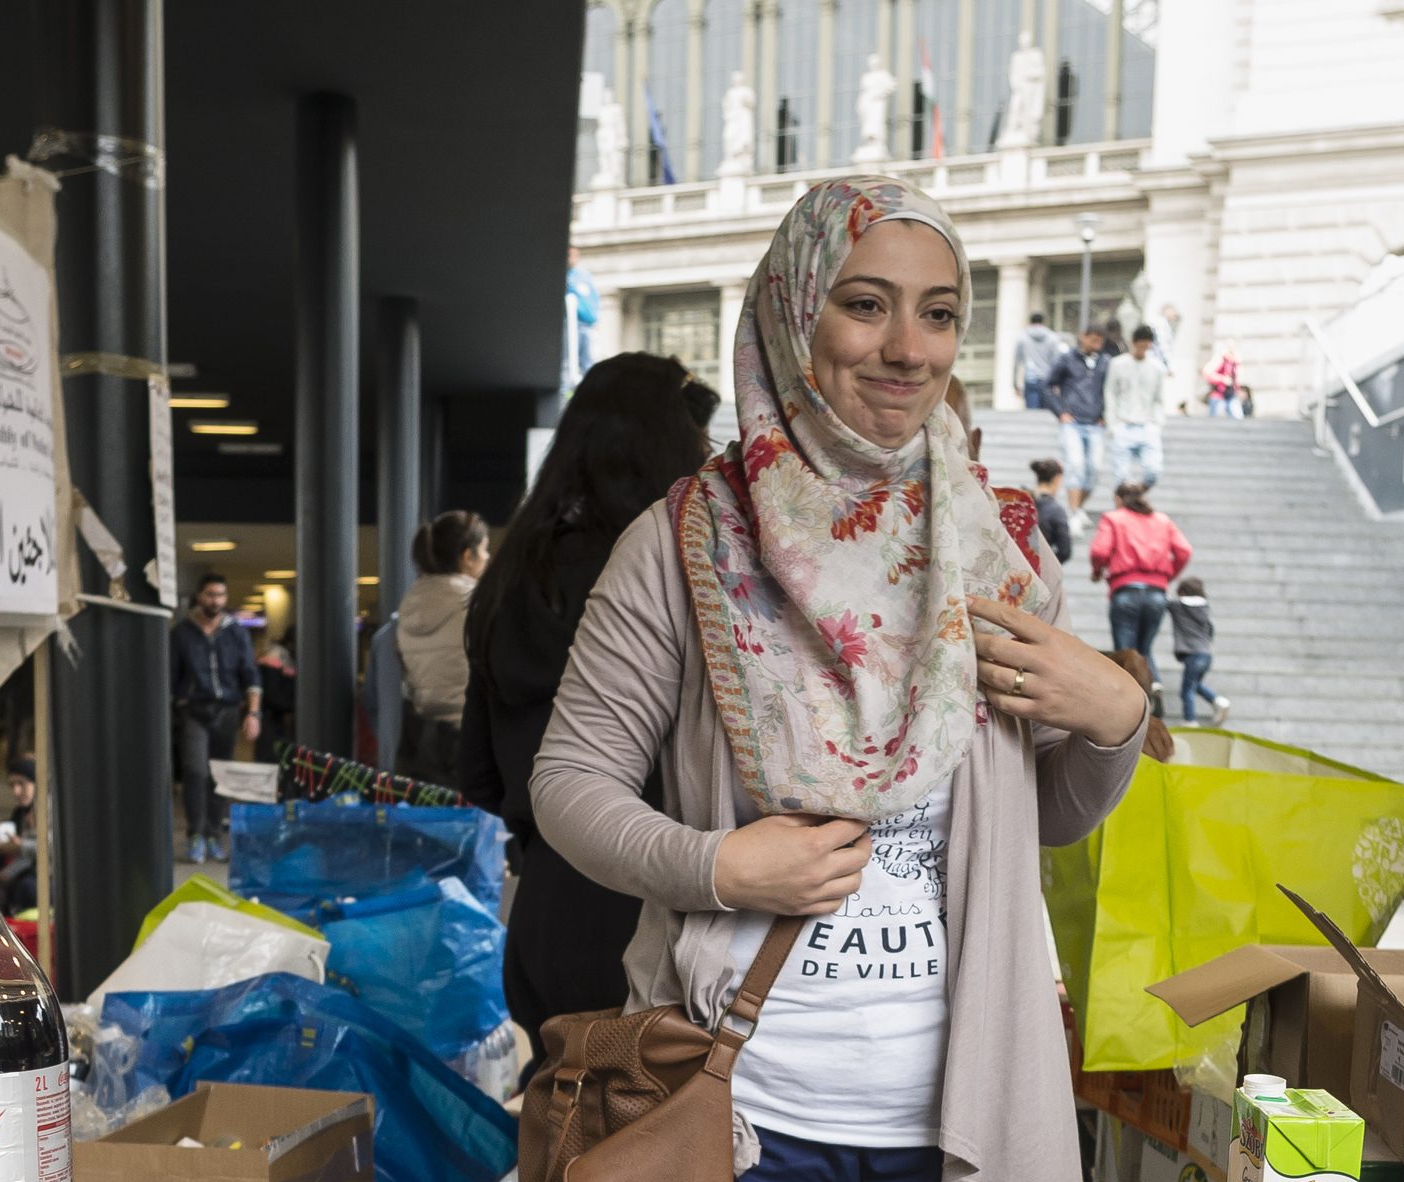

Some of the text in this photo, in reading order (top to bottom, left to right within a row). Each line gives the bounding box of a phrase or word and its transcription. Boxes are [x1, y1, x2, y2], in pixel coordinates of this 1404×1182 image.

[807, 920, 935, 955] EAUT
[801, 959, 939, 979] DE VILLE
